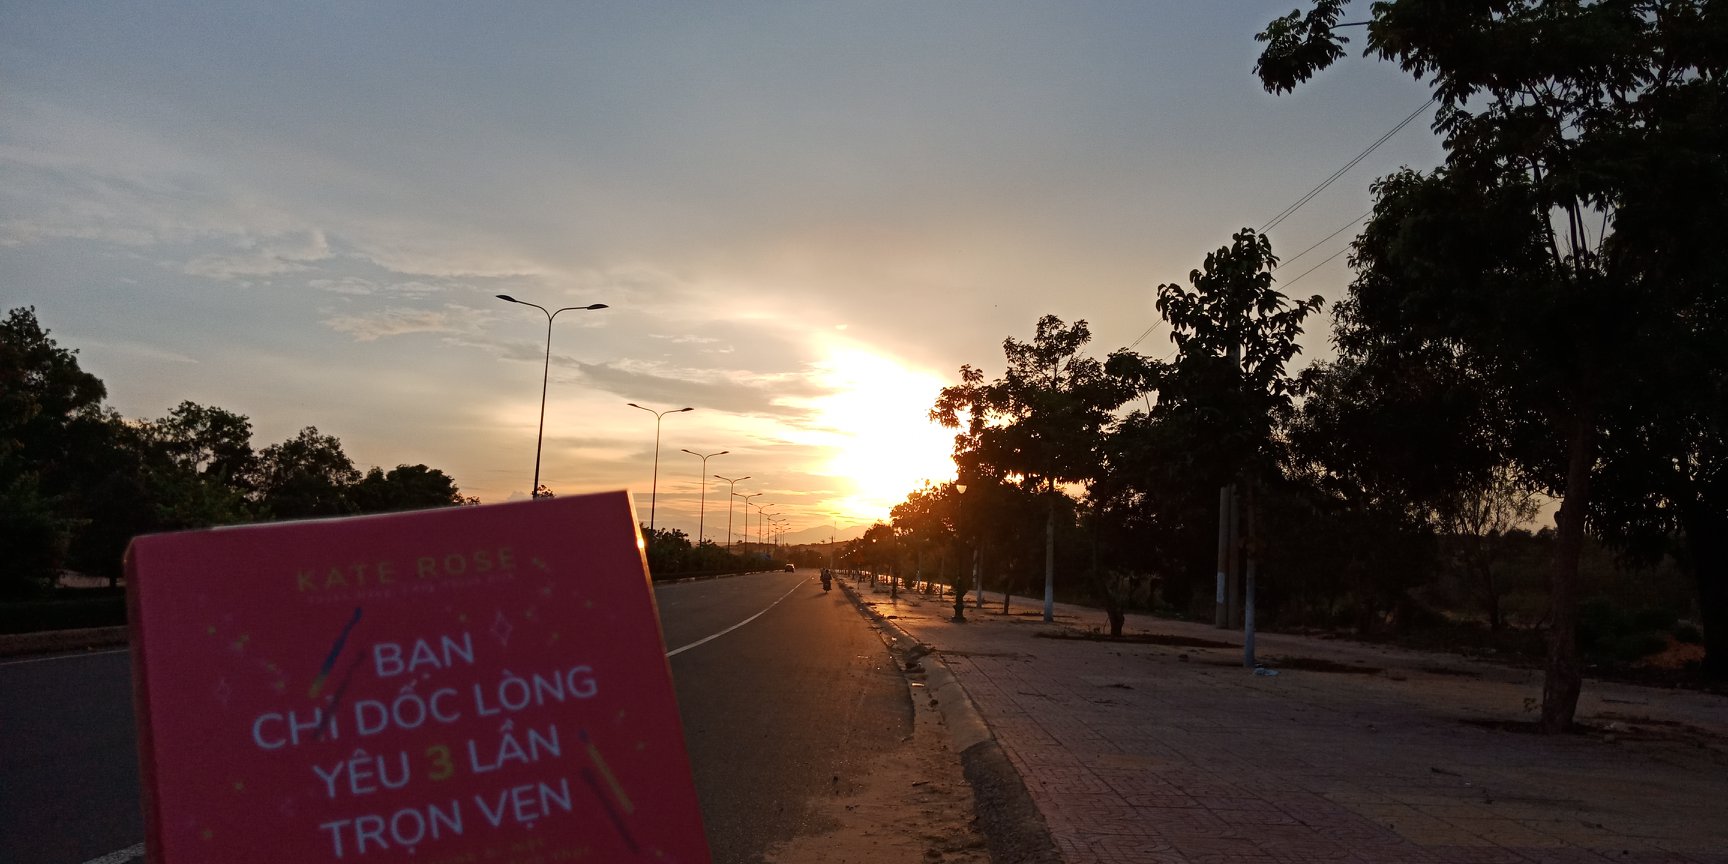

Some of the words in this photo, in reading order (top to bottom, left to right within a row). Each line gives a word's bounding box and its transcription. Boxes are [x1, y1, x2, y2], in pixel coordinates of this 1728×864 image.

[297, 560, 396, 592] KATE
[417, 547, 516, 579] ROSE
[373, 631, 475, 680] BẠN
[354, 678, 461, 737] DỐC
[474, 665, 599, 717] LÒNG
[311, 748, 411, 799] YÊU
[426, 744, 455, 782] 3
[319, 799, 465, 860] TRỌN
[474, 777, 573, 831] VẸN
